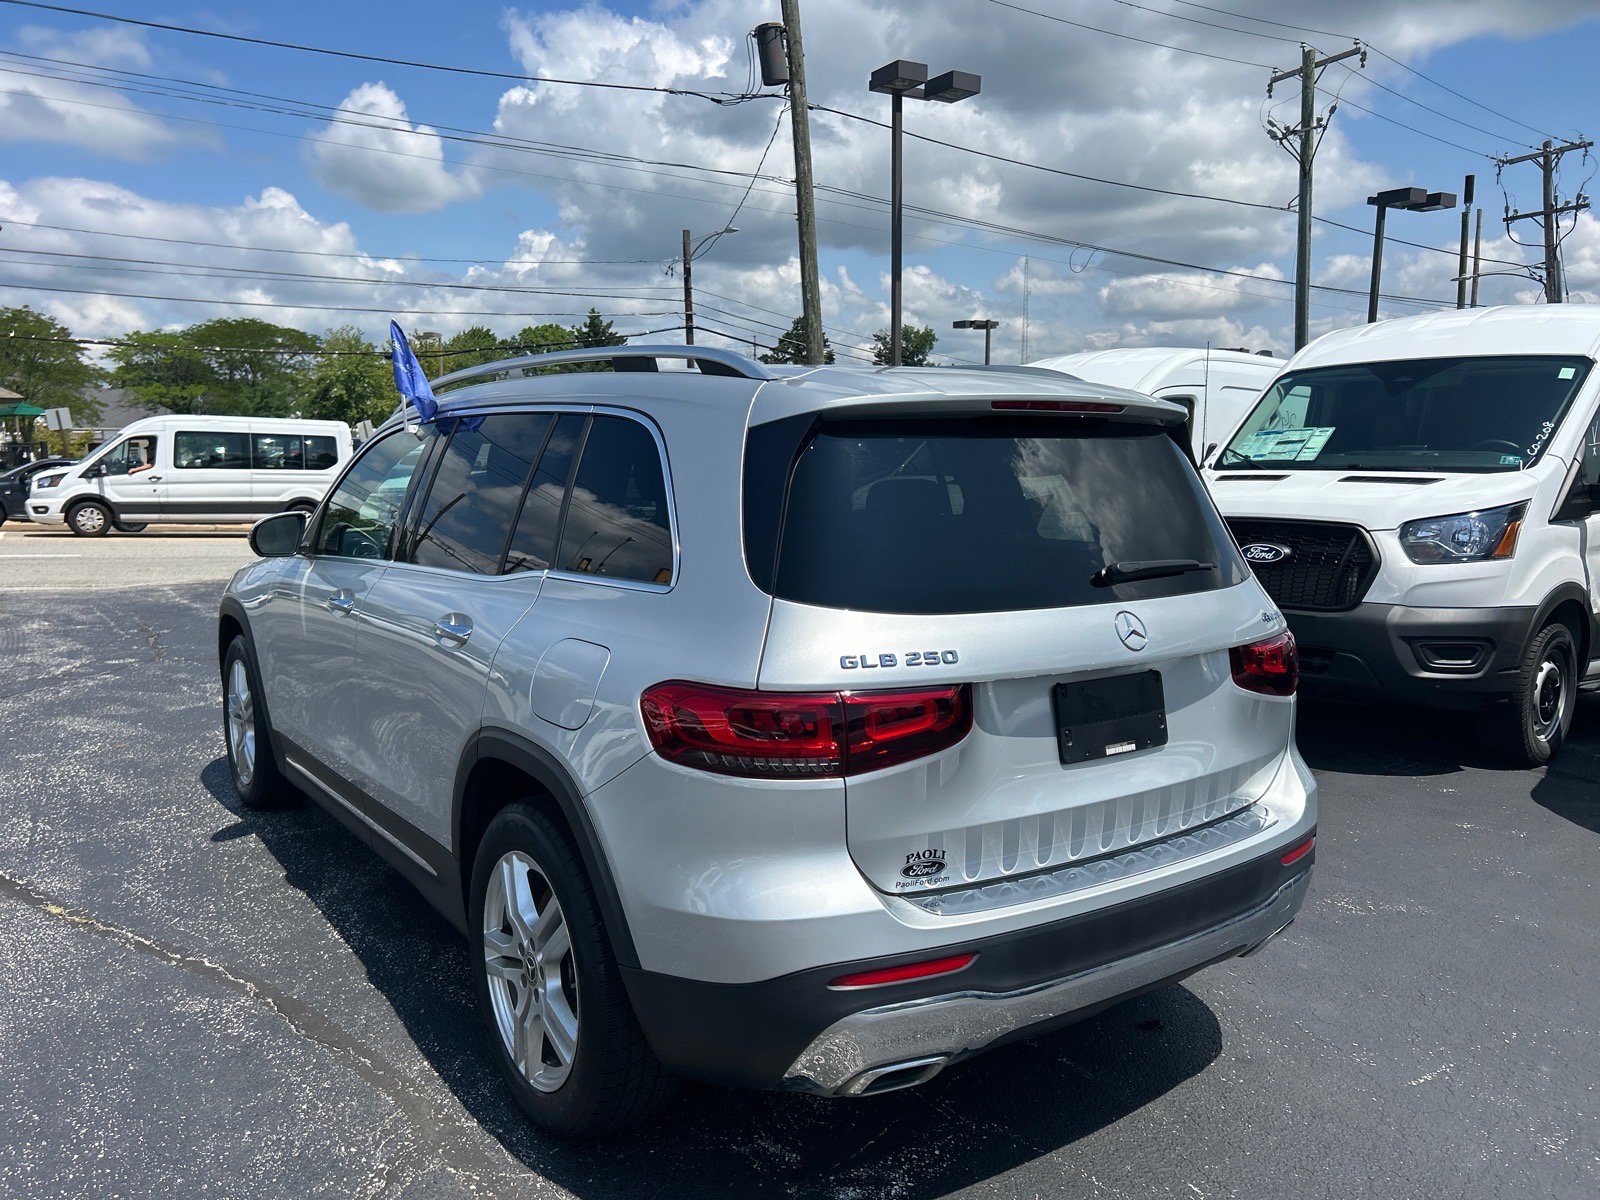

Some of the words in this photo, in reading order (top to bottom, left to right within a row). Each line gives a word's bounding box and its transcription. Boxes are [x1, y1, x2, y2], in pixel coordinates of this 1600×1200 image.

[1247, 546, 1276, 559] Ford
[840, 653, 898, 670] GLB
[905, 649, 959, 667] 250
[905, 848, 946, 865] PAOLI
[909, 862, 939, 876] Ford
[895, 876, 950, 889] PaoliFord.com
